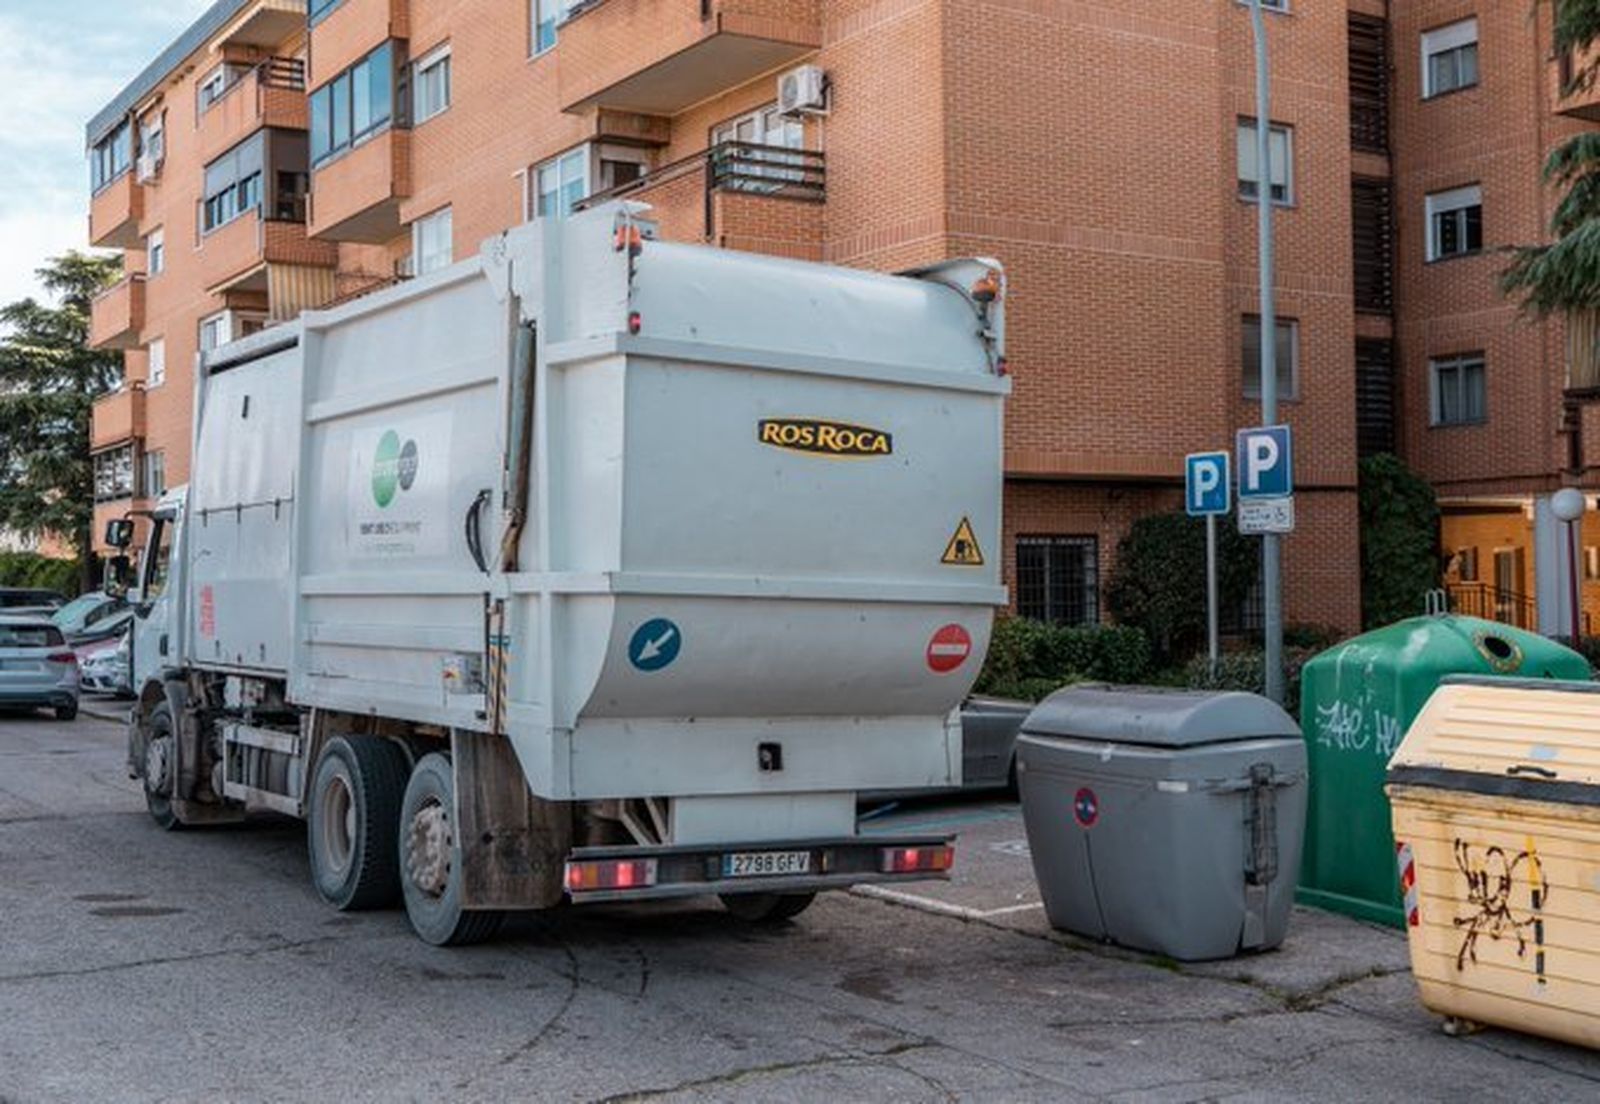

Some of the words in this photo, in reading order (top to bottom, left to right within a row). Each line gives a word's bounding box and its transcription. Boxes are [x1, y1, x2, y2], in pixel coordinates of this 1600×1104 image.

[763, 423, 815, 446] ROS
[817, 425, 889, 453] ROCA
[1247, 434, 1279, 490] P
[1194, 460, 1219, 508] P
